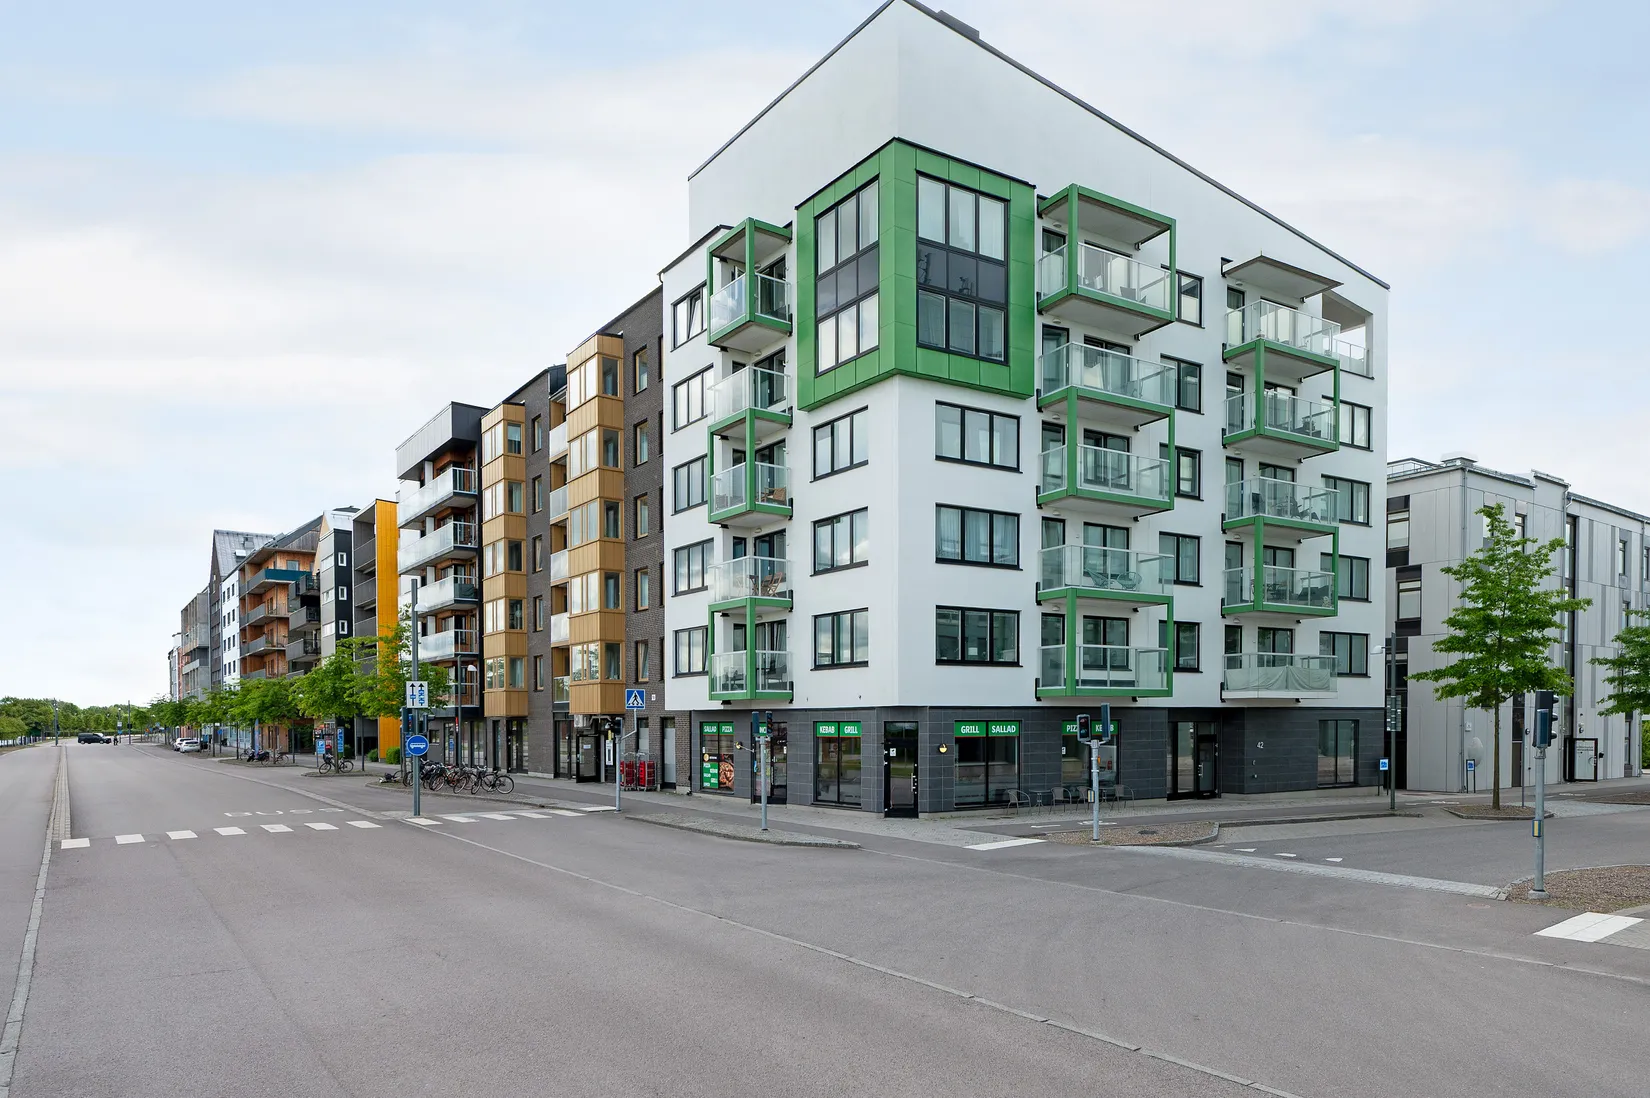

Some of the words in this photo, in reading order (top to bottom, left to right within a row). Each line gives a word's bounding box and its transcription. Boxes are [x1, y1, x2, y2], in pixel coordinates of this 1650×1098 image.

[819, 725, 835, 734] KEBAB
[844, 725, 858, 734] GRILL
[960, 725, 980, 734] GRILL
[991, 725, 1016, 733] SALLAD
[1095, 724, 1115, 732] KEB
